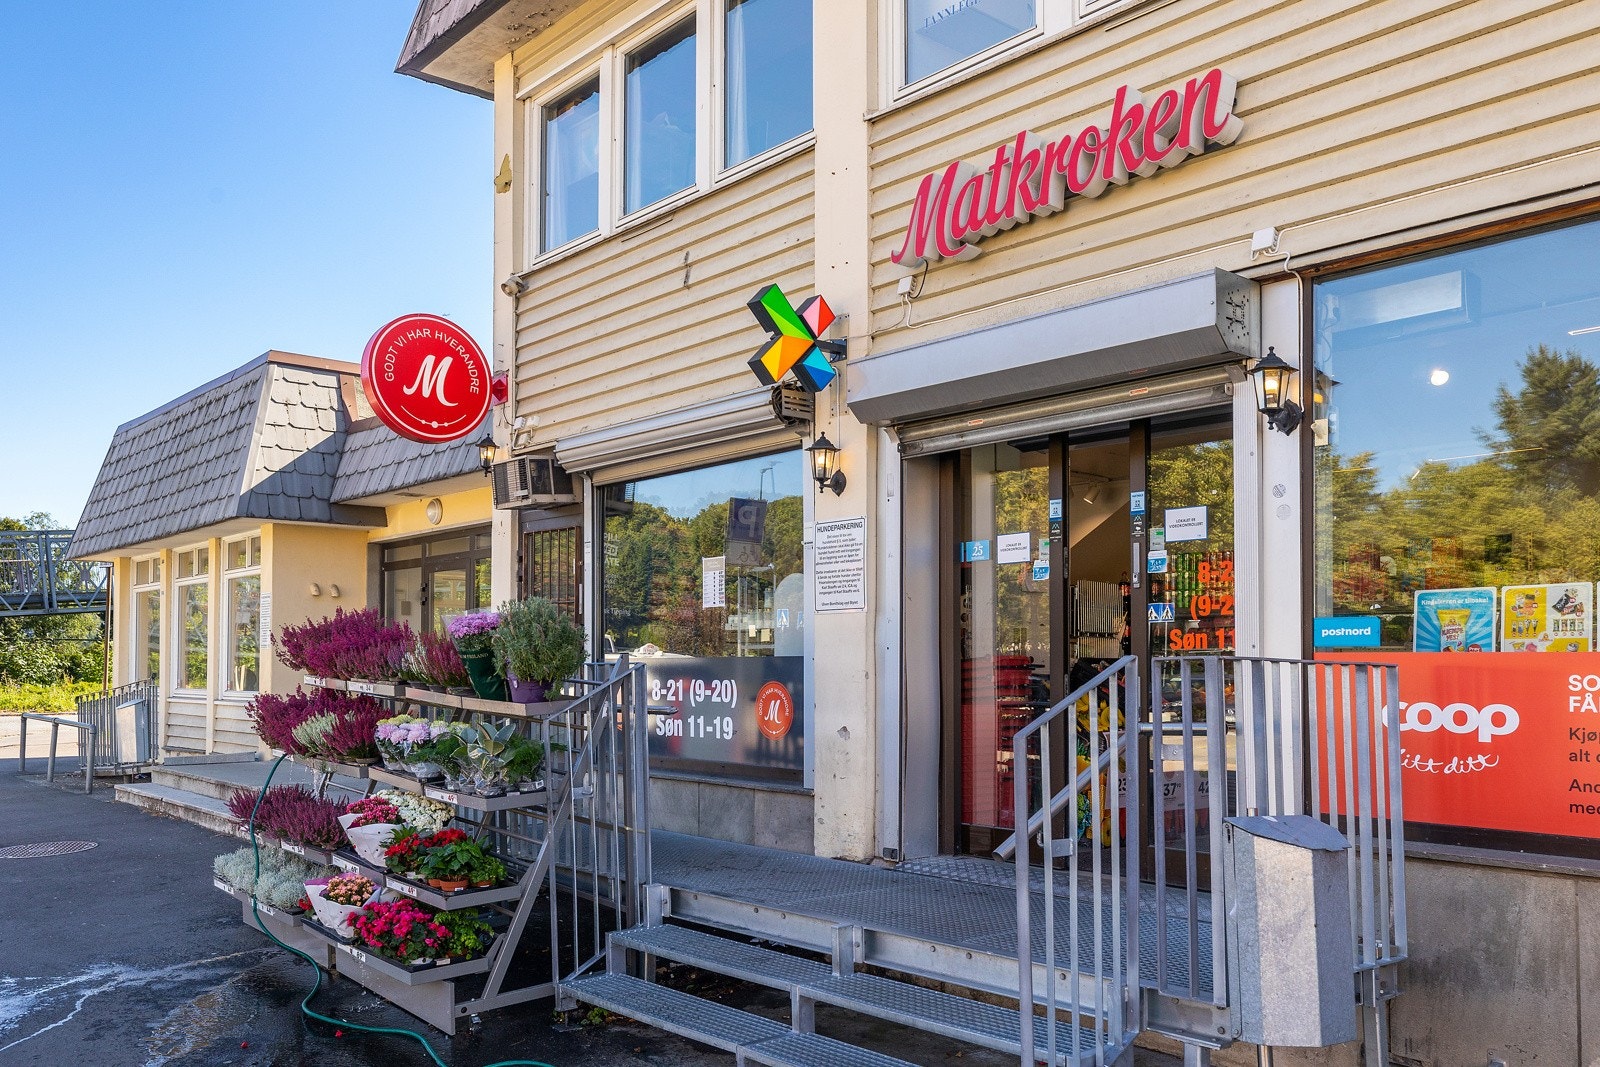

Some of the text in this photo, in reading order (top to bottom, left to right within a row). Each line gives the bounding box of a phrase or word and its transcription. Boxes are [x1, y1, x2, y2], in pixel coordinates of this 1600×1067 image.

[891, 68, 1231, 264] Matkroken
[384, 328, 480, 395] GODT VI HAR HVERANDRE
[402, 354, 459, 407] M
[817, 522, 863, 533] HUNDEPARKERING
[972, 545, 984, 557] 25
[1169, 628, 1208, 650] Søn
[1321, 626, 1371, 638] postnord
[651, 679, 738, 709] 8-21 (9-20)
[1569, 692, 1600, 713] FÅ
[764, 699, 783, 724] M
[655, 714, 734, 740] Søn 11-19
[1569, 727, 1600, 744] Kjø
[1400, 748, 1444, 774] itt
[1568, 748, 1591, 763] alt
